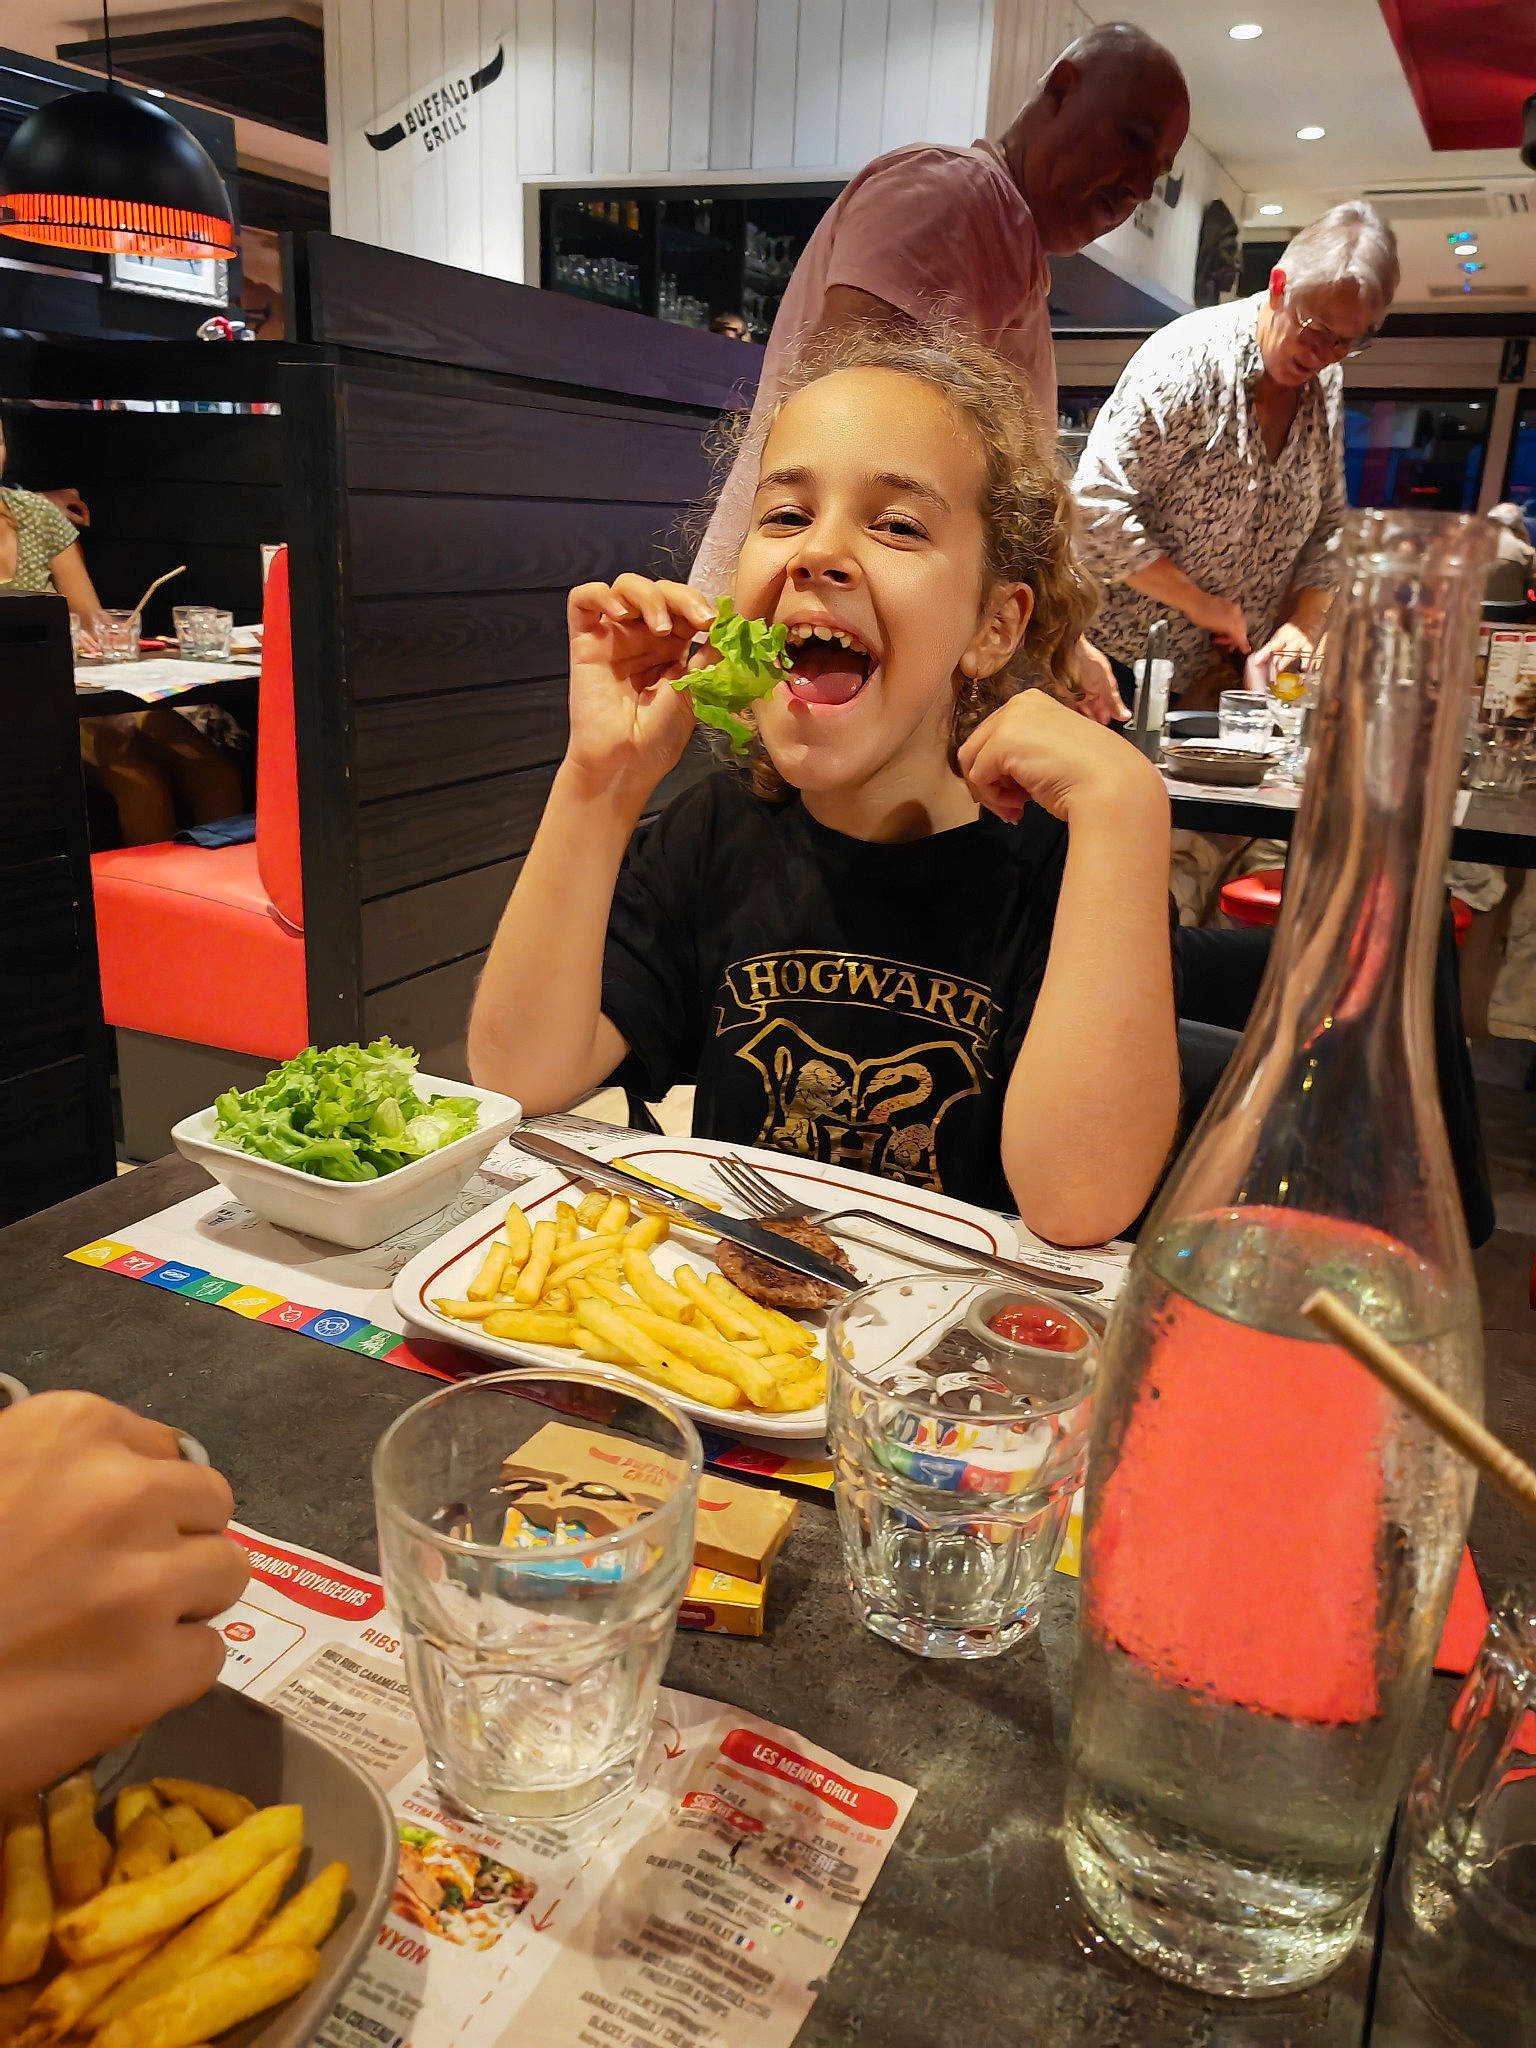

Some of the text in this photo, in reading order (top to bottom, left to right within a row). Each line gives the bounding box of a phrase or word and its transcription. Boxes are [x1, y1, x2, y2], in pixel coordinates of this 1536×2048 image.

[404, 79, 469, 135] BUFFALO
[422, 112, 467, 152] GRILL
[292, 1568, 373, 1607] VOYAGEURS
[359, 1627, 402, 1655] RIBS
[752, 1743, 780, 1767] LES
[777, 1756, 825, 1790] MENUS
[820, 1777, 861, 1809] GRILL
